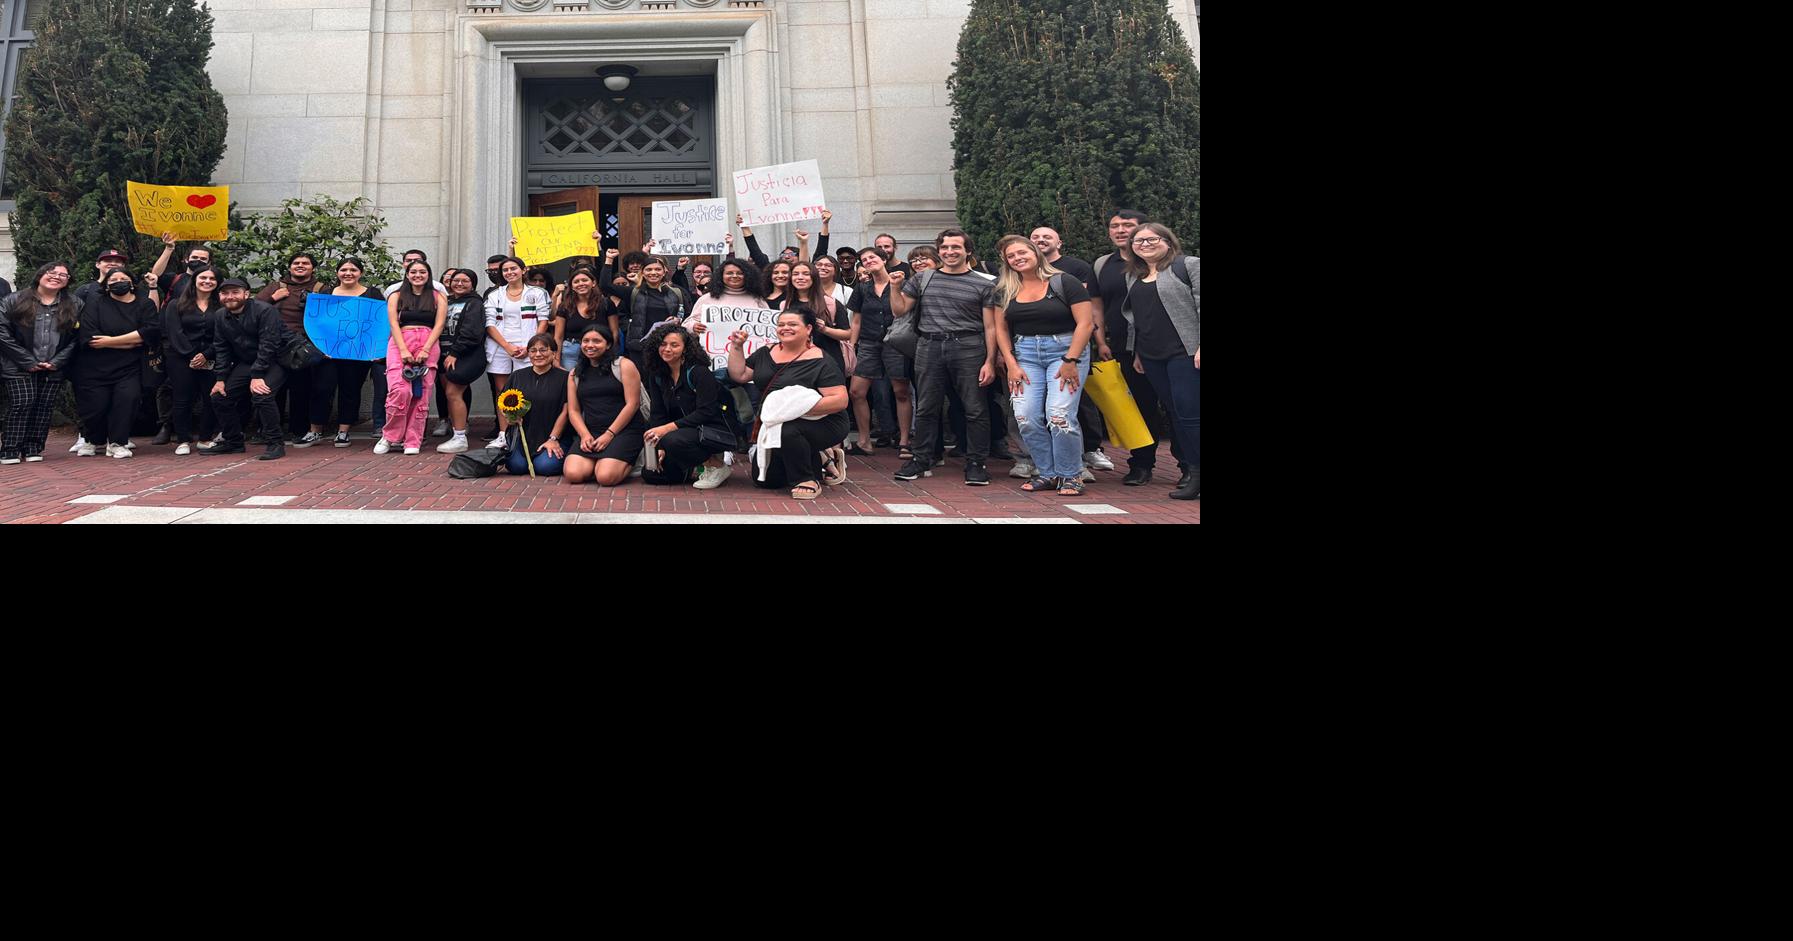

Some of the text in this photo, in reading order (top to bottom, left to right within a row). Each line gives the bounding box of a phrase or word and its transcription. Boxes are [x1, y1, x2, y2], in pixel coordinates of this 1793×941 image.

[548, 173, 690, 184] CALIFORNIA HALL
[736, 172, 808, 195] Justicia
[134, 190, 173, 209] We
[761, 192, 790, 207] Para
[139, 207, 217, 222] Ivonne
[656, 201, 726, 225] Justice
[672, 223, 694, 239] for
[658, 238, 726, 255] Ivonne
[308, 296, 387, 321] JUSTIC
[706, 305, 780, 326] PROTEC
[336, 319, 374, 342] FOR
